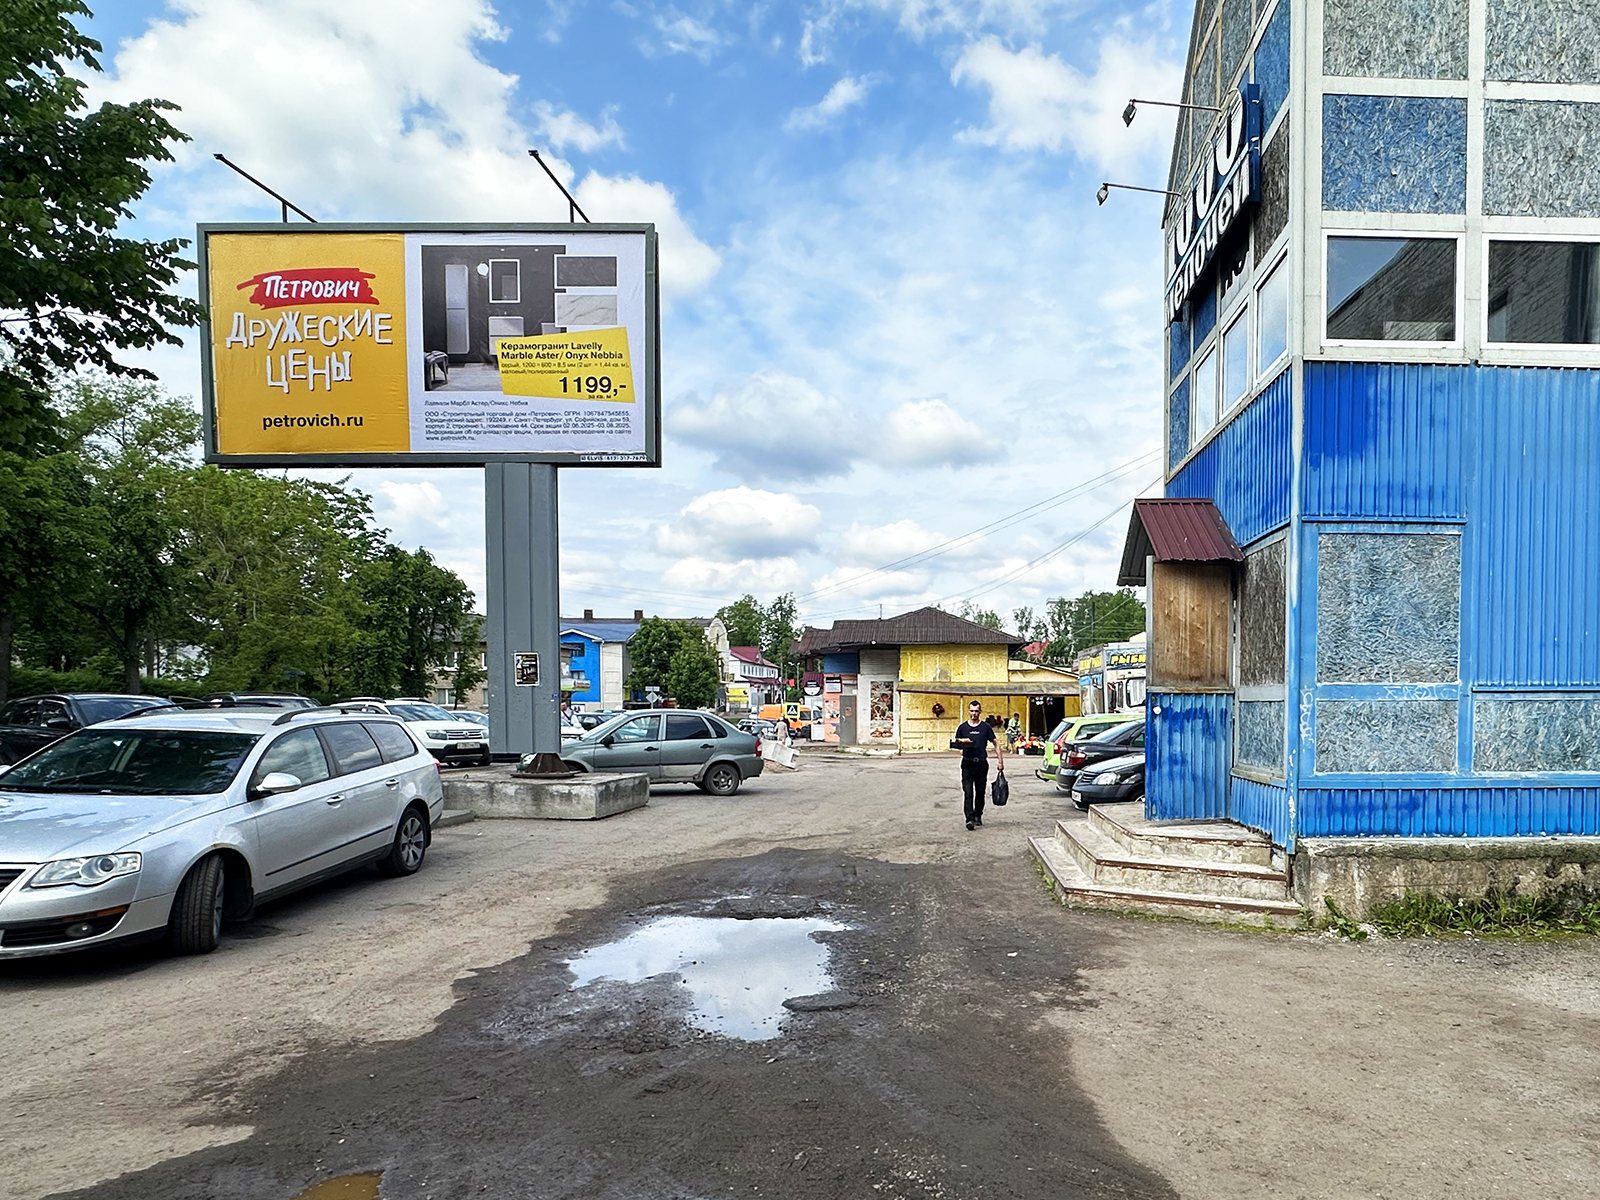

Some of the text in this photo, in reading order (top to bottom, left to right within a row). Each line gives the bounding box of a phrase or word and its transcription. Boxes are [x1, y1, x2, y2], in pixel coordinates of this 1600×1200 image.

[225, 309, 393, 350] ДРУЖЕСКИЕ
[501, 342, 602, 351] Керамогранит Lavelly
[501, 351, 533, 360] Marble
[565, 351, 589, 360] Onyx
[591, 351, 623, 359] Nebbia
[266, 348, 352, 394] ЦЕНЫ
[262, 414, 364, 430] petrovich.ru
